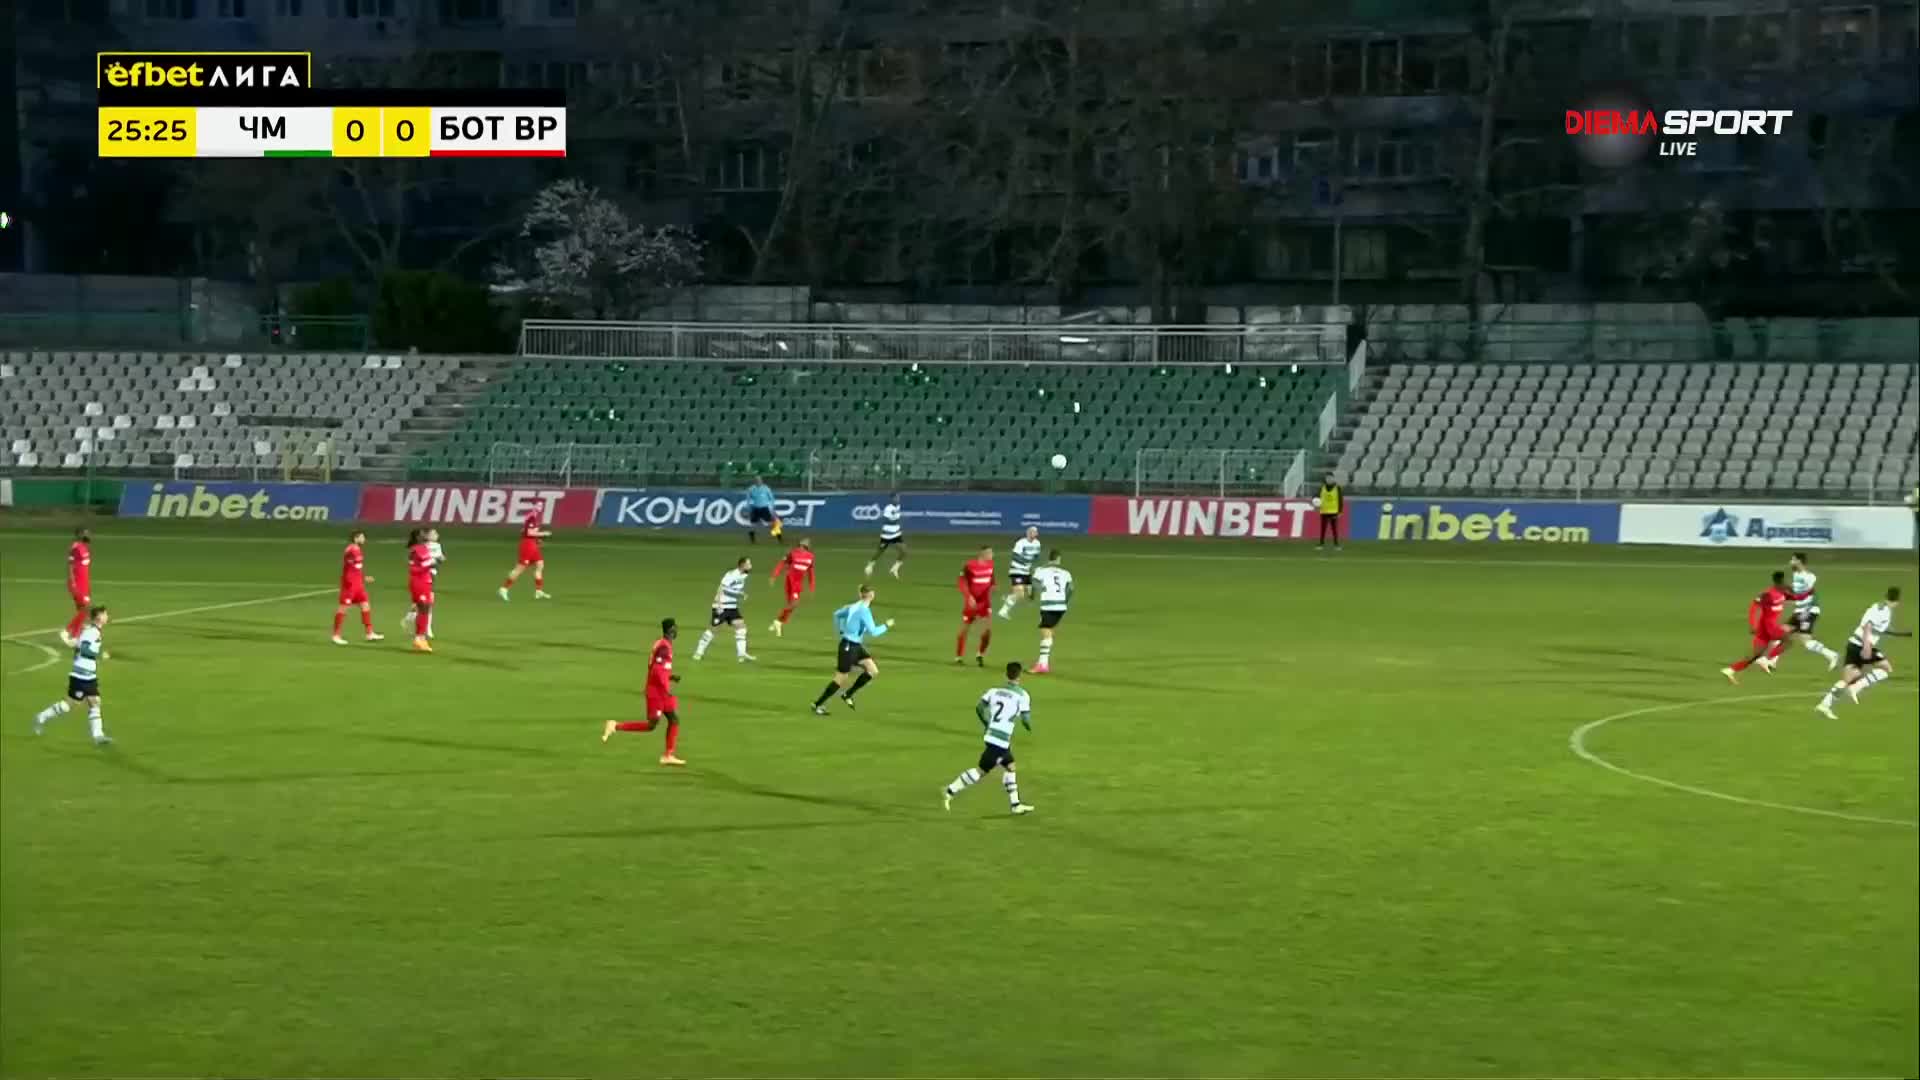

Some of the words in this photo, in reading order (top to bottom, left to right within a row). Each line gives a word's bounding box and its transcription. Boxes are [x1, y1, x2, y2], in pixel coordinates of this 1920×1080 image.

[147, 483, 329, 521] inbet.com
[393, 487, 566, 525] WINBET
[1127, 498, 1315, 538] WINBET
[1377, 503, 1590, 543] inbet.com
[1053, 575, 1062, 593] 5
[992, 701, 1005, 723] 2
